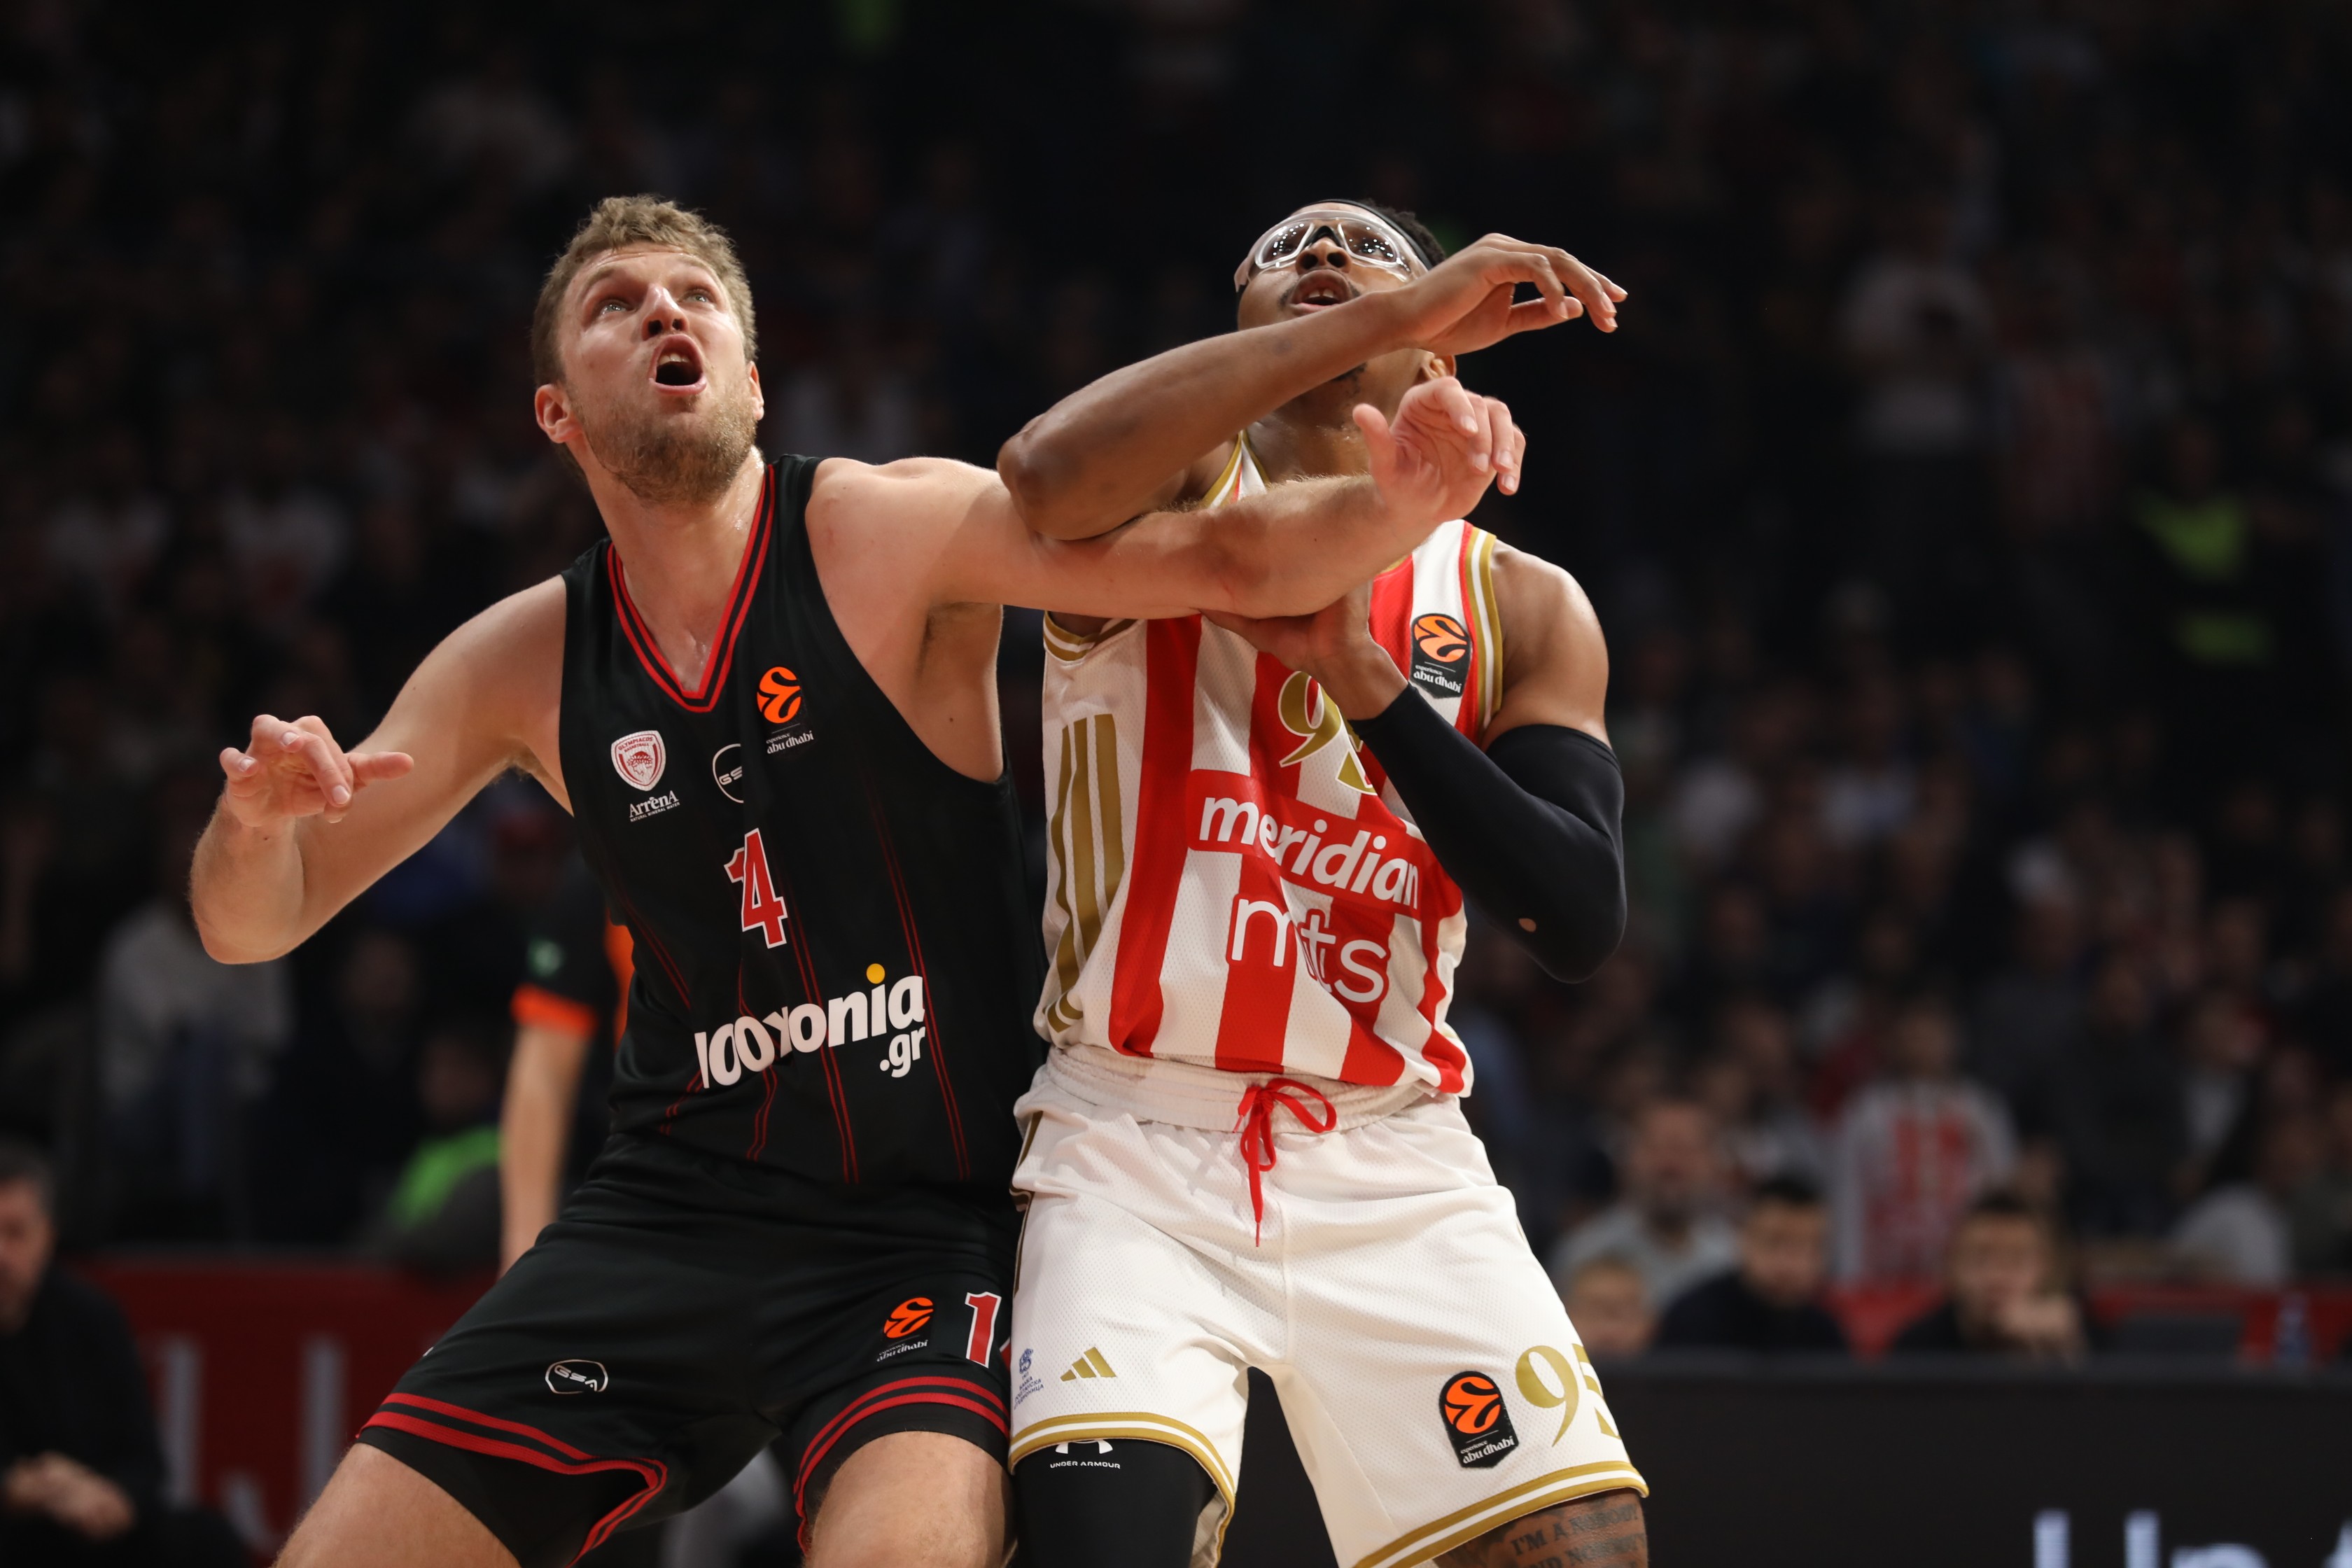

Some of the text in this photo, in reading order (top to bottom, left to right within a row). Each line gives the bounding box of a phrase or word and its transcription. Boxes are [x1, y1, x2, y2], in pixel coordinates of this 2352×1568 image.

[1413, 671, 1462, 693] abu dhabi
[618, 736, 653, 750] OLYMPIACOS
[767, 730, 814, 754] abu dhabi
[719, 766, 743, 785] GS
[1199, 797, 1418, 909] meridian
[1231, 898, 1387, 1002] mts
[879, 1026, 925, 1078] .gr
[1463, 1436, 1515, 1464] abu dhabi
[1050, 1460, 1121, 1469] UNDER ARMOUR
[1553, 1521, 1569, 1541] A
